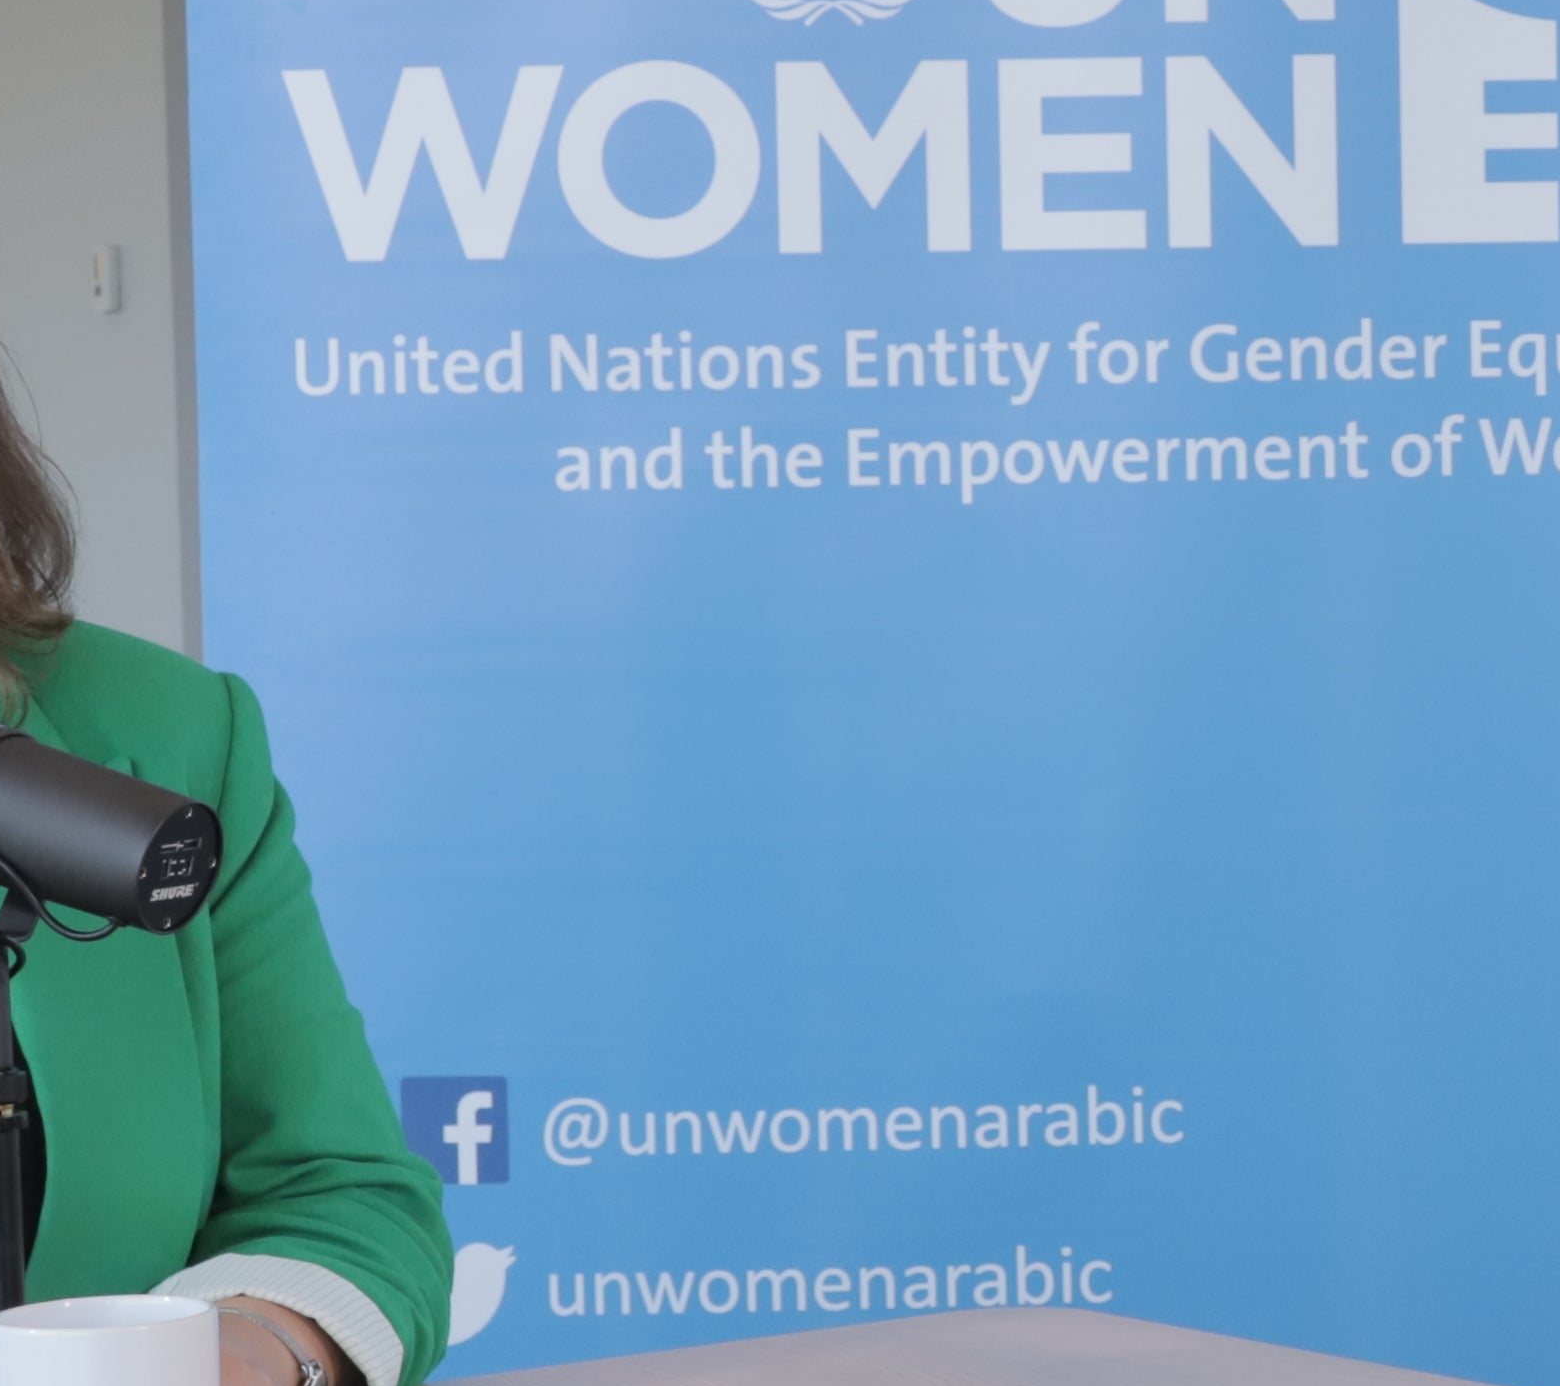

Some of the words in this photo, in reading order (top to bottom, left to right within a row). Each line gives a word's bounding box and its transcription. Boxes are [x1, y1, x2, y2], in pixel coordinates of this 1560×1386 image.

[280, 53, 1340, 264] WOMEN
[293, 330, 523, 398] United
[549, 329, 821, 393] Nations
[844, 325, 1051, 407] Entity
[1068, 321, 1170, 386] for
[1189, 316, 1448, 384] Gender
[554, 425, 683, 493] and
[703, 425, 824, 490] the
[847, 420, 1370, 505] Empowerment
[1390, 413, 1466, 479] of
[149, 884, 196, 902] SHURE
[543, 1084, 1185, 1167] @unwomenarabic
[548, 1244, 1115, 1319] unwomenarabic
